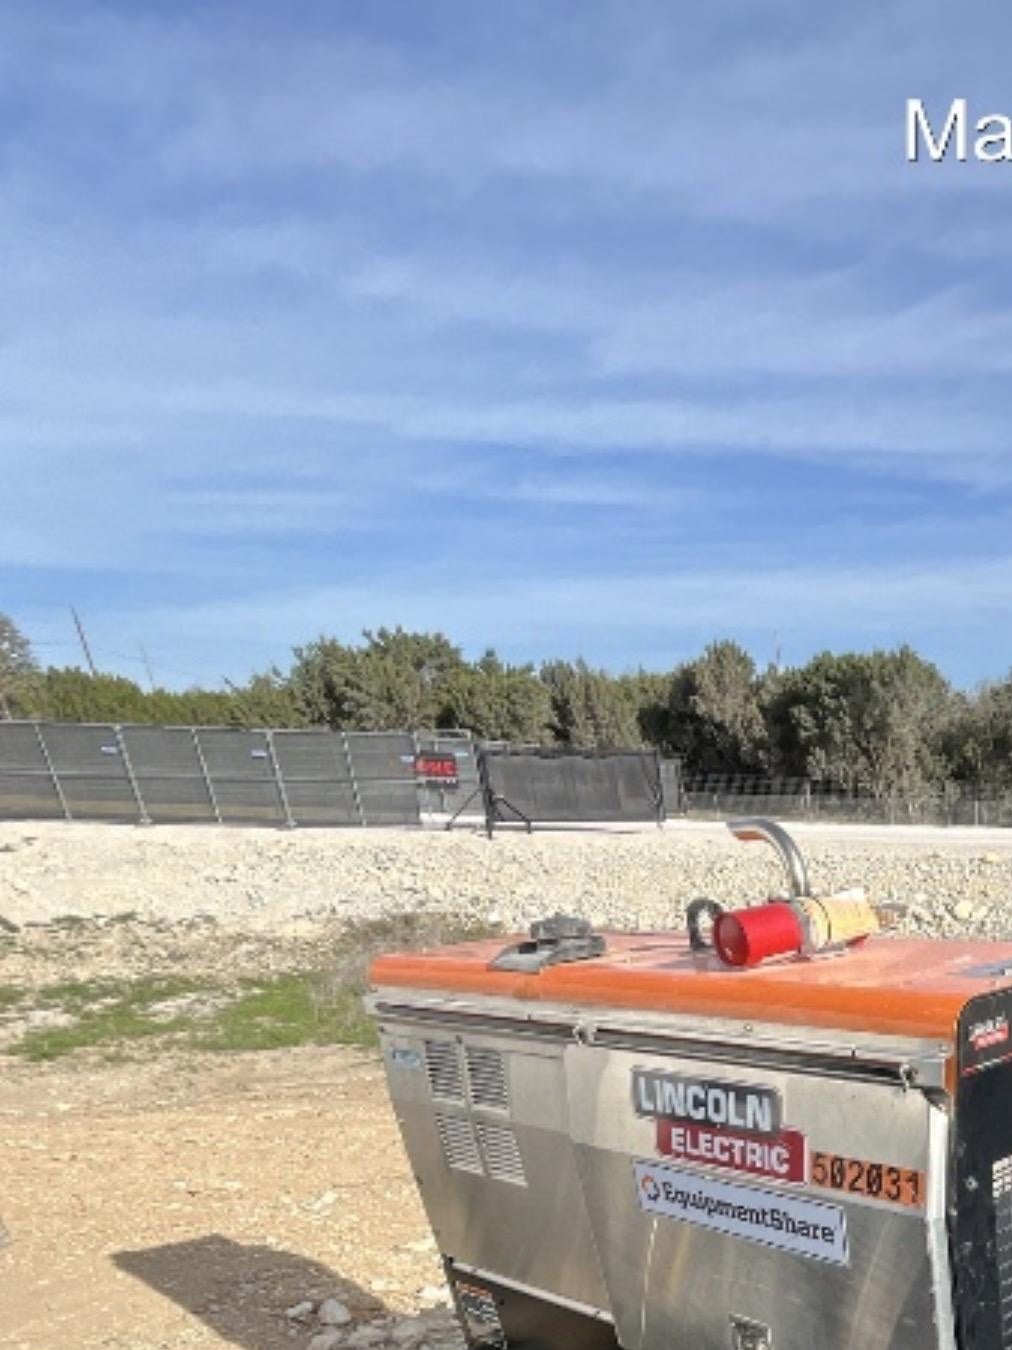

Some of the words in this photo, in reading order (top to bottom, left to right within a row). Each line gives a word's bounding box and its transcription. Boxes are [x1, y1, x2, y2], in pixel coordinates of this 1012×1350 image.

[638, 1076, 772, 1132] LINCOLN
[670, 1127, 791, 1174] ELECTRIC
[812, 1153, 920, 1203] 502031
[662, 1181, 836, 1245] EquipmentShare
